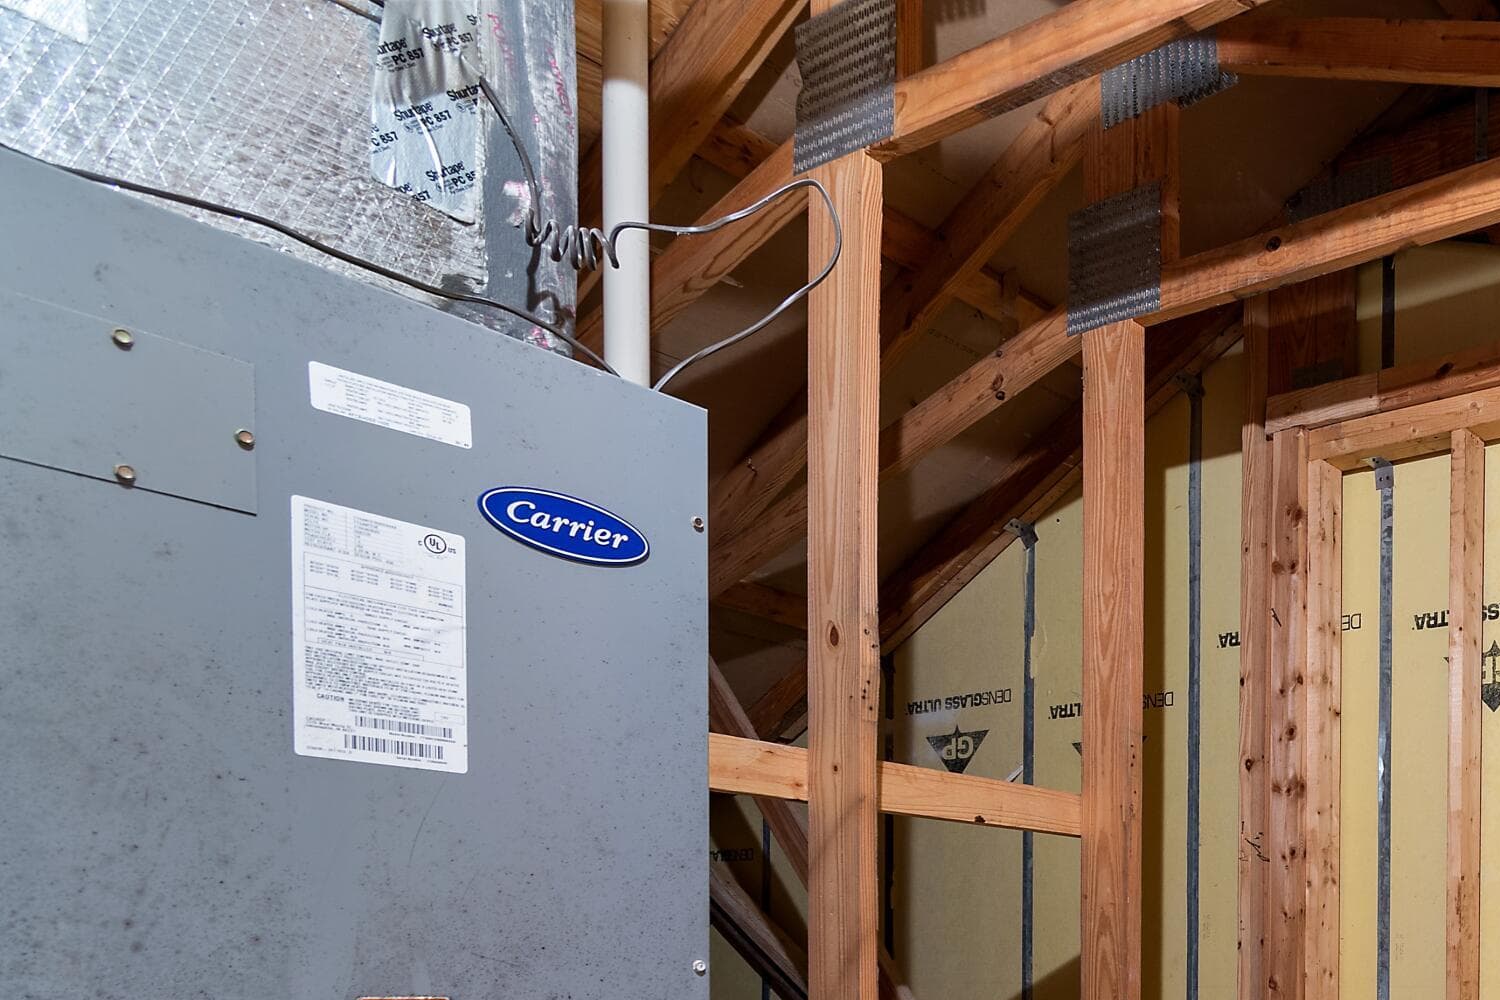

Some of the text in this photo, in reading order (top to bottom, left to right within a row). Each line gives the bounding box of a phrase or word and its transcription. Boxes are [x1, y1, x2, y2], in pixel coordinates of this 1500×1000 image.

[391, 47, 425, 65] PC 857
[433, 109, 452, 122] 857
[380, 131, 399, 144] 857
[451, 175, 466, 187] PC
[506, 500, 629, 549] Carrier
[429, 537, 442, 551] UL
[316, 693, 345, 702] CAUTION
[905, 688, 1012, 715] DENSGLASS ULTRA
[940, 736, 974, 760] GP
